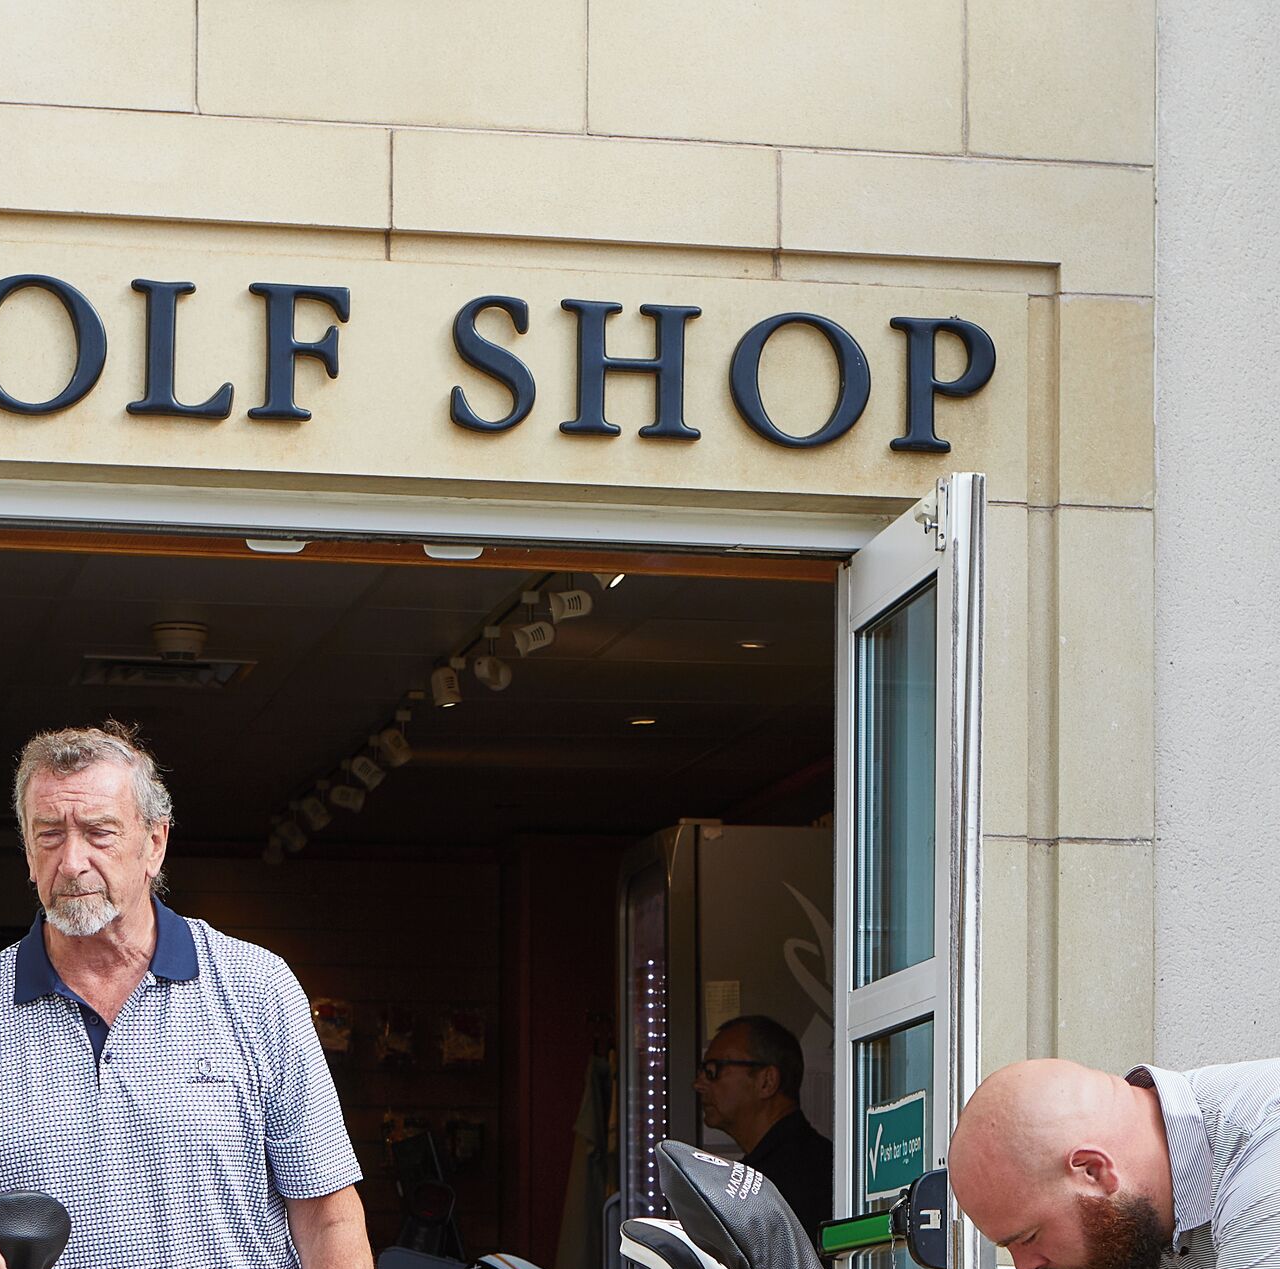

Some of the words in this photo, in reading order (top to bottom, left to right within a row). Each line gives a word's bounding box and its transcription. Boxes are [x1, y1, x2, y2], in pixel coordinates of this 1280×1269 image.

[449, 294, 998, 454] SHOP
[880, 1142, 893, 1162] Push
[893, 1140, 902, 1159] bar
[902, 1138, 908, 1156] to
[908, 1136, 921, 1158] open
